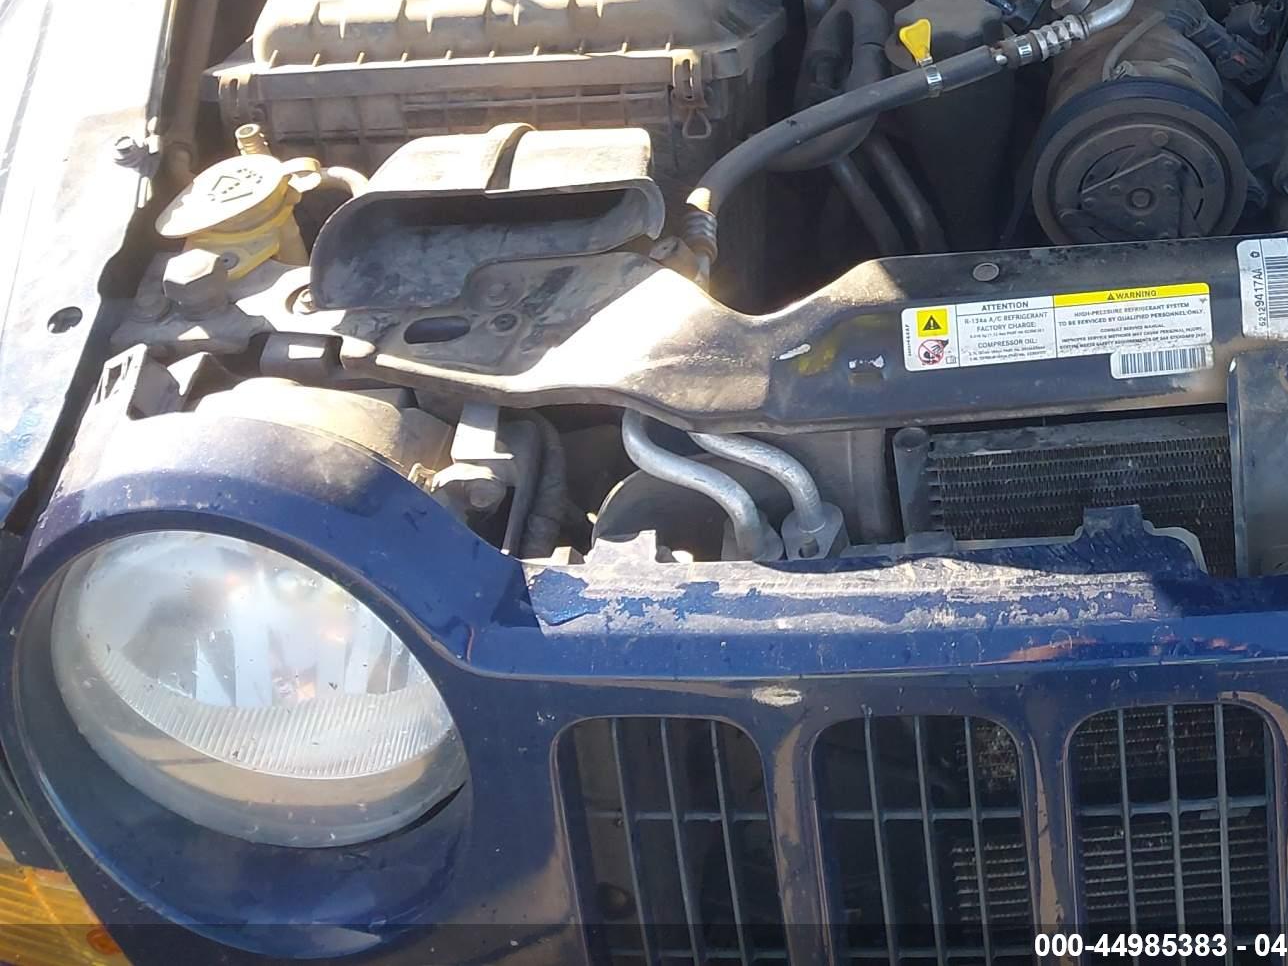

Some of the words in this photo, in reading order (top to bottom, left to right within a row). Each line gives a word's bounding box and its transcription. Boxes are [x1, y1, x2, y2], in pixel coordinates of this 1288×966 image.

[1115, 289, 1156, 299] WARNING
[981, 300, 1028, 311] ATTENTION
[1003, 311, 1048, 321] REFRIGERANT
[1077, 316, 1106, 324] SERVICED
[1117, 313, 1149, 321] QUALIFIED
[1150, 310, 1187, 318] PERSONNEL
[976, 323, 1006, 331] FACTORY
[977, 339, 1022, 348] COMPRESSOR
